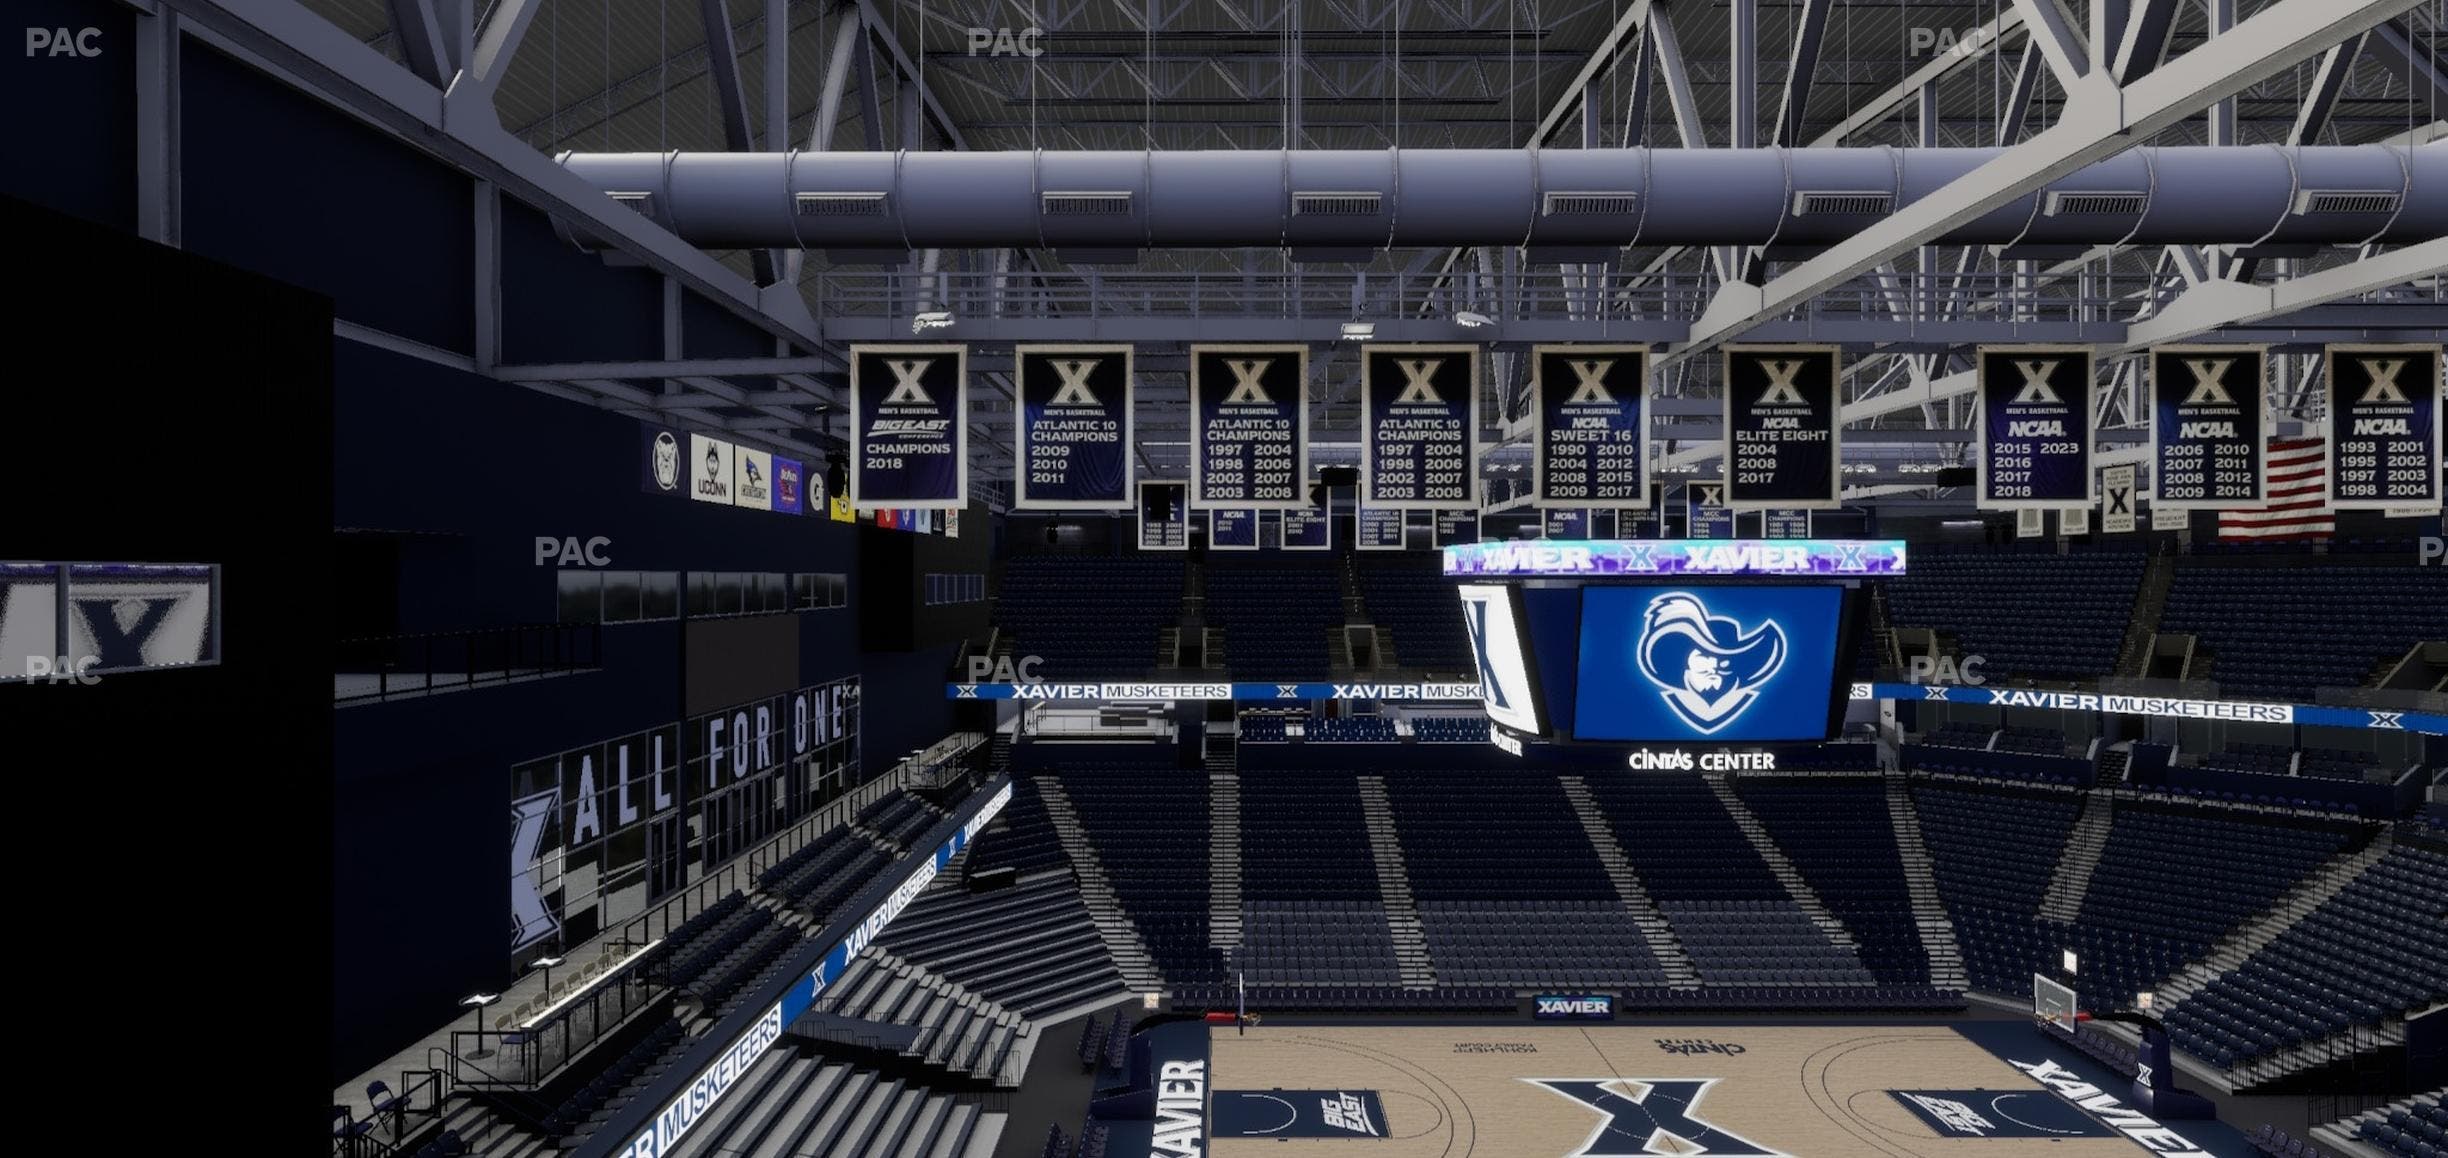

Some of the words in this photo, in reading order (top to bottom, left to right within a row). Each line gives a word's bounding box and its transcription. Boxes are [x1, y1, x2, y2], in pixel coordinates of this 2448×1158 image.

[881, 359, 935, 404] X
[1046, 359, 1103, 406] X
[1221, 359, 1275, 404] X
[1392, 359, 1446, 404] X
[1564, 359, 1618, 404] X
[1754, 359, 1809, 405] X
[2009, 360, 2064, 404] X
[2181, 359, 2237, 405] X
[2356, 359, 2411, 404] X
[1033, 421, 1099, 430] ATLANTIC
[1103, 421, 1116, 430] 10
[1208, 420, 1272, 429] ATLANTIC
[1275, 420, 1289, 429] 10
[1379, 420, 1443, 429] ATLANTIC
[1446, 420, 1460, 429] 10
[1032, 432, 1118, 442] CHAMPIONS
[1207, 431, 1290, 441] CHAMPIONS
[1378, 431, 1461, 441] CHAMPIONS
[1551, 430, 1609, 441] SWEET
[1614, 430, 1632, 441] 16
[1736, 431, 1779, 441] ELITE
[1783, 431, 1829, 441] EIGHT
[867, 444, 951, 454] CHAMPIONS
[1032, 446, 1069, 456] 2009
[1208, 445, 1243, 456] 1997
[1254, 445, 1292, 456] 2004
[1379, 445, 1414, 456] 1997
[1425, 445, 1462, 456] 2004
[1551, 445, 1586, 455] 1990
[1597, 445, 1633, 455] 2010
[1738, 445, 1777, 455] 2004
[1995, 443, 2031, 454] 2015
[2040, 443, 2079, 454] 2023
[2165, 445, 2204, 456] 2006
[2214, 444, 2250, 455] 2010
[2340, 442, 2376, 453] 1993
[2388, 442, 2424, 453] 2001
[867, 458, 903, 469] 2018
[1032, 460, 1068, 470] 2010
[1208, 459, 1243, 470] 1998
[1254, 459, 1292, 470] 2006
[1379, 459, 1414, 470] 1998
[1425, 459, 1462, 470] 2006
[1549, 459, 1587, 469] 2004
[1597, 459, 1633, 469] 2012
[1738, 459, 1776, 469] 2008
[1995, 457, 2031, 468] 2016
[2165, 459, 2204, 470] 2007
[2215, 458, 2247, 469] 2011
[2340, 456, 2376, 467] 1995
[2387, 456, 2427, 467] 2002
[1032, 473, 1064, 483] 2011
[1207, 473, 1244, 484] 2002
[1254, 473, 1291, 484] 2007
[1378, 473, 1415, 484] 2002
[1425, 473, 1462, 484] 2007
[1550, 472, 1587, 483] 2008
[1597, 472, 1633, 482] 2015
[1738, 472, 1774, 483] 2017
[1995, 472, 2031, 482] 2017
[2165, 473, 2204, 484] 2008
[2215, 472, 2252, 483] 2012
[2340, 471, 2376, 481] 1997
[2387, 470, 2427, 481] 2003
[698, 479, 727, 498] UCONN
[1207, 487, 1244, 498] 2003
[1254, 487, 1292, 498] 2008
[1378, 487, 1415, 498] 2003
[1425, 487, 1463, 498] 2008
[1550, 486, 1588, 497] 2009
[1597, 486, 1633, 497] 2017
[1995, 486, 2032, 497] 2018
[2165, 487, 2204, 498] 2009
[2216, 486, 2251, 497] 2014
[2340, 485, 2377, 495] 1998
[2388, 485, 2428, 495] 2004
[2109, 487, 2129, 514] X
[1684, 547, 1810, 570] XAVIER
[1012, 684, 1099, 699] XAVIER
[1106, 685, 1229, 698] MUSKETEERS
[1332, 684, 1419, 699] XAVIER
[1989, 690, 2100, 712] XAVIER
[2109, 698, 2288, 721] MUSKETEERS
[1629, 747, 1694, 771] CINTAS
[1699, 752, 1776, 771] CENTER
[573, 735, 672, 846] ALL
[710, 706, 772, 789] FOR
[795, 685, 842, 754] ONE
[845, 903, 889, 966] XAVIER
[1538, 1001, 1609, 1013] XAVIER
[664, 1009, 778, 1147] MUSKETEERS
[2137, 1062, 2152, 1087] X
[1321, 1098, 1345, 1127] BIG
[1339, 1091, 1367, 1133] EAST
